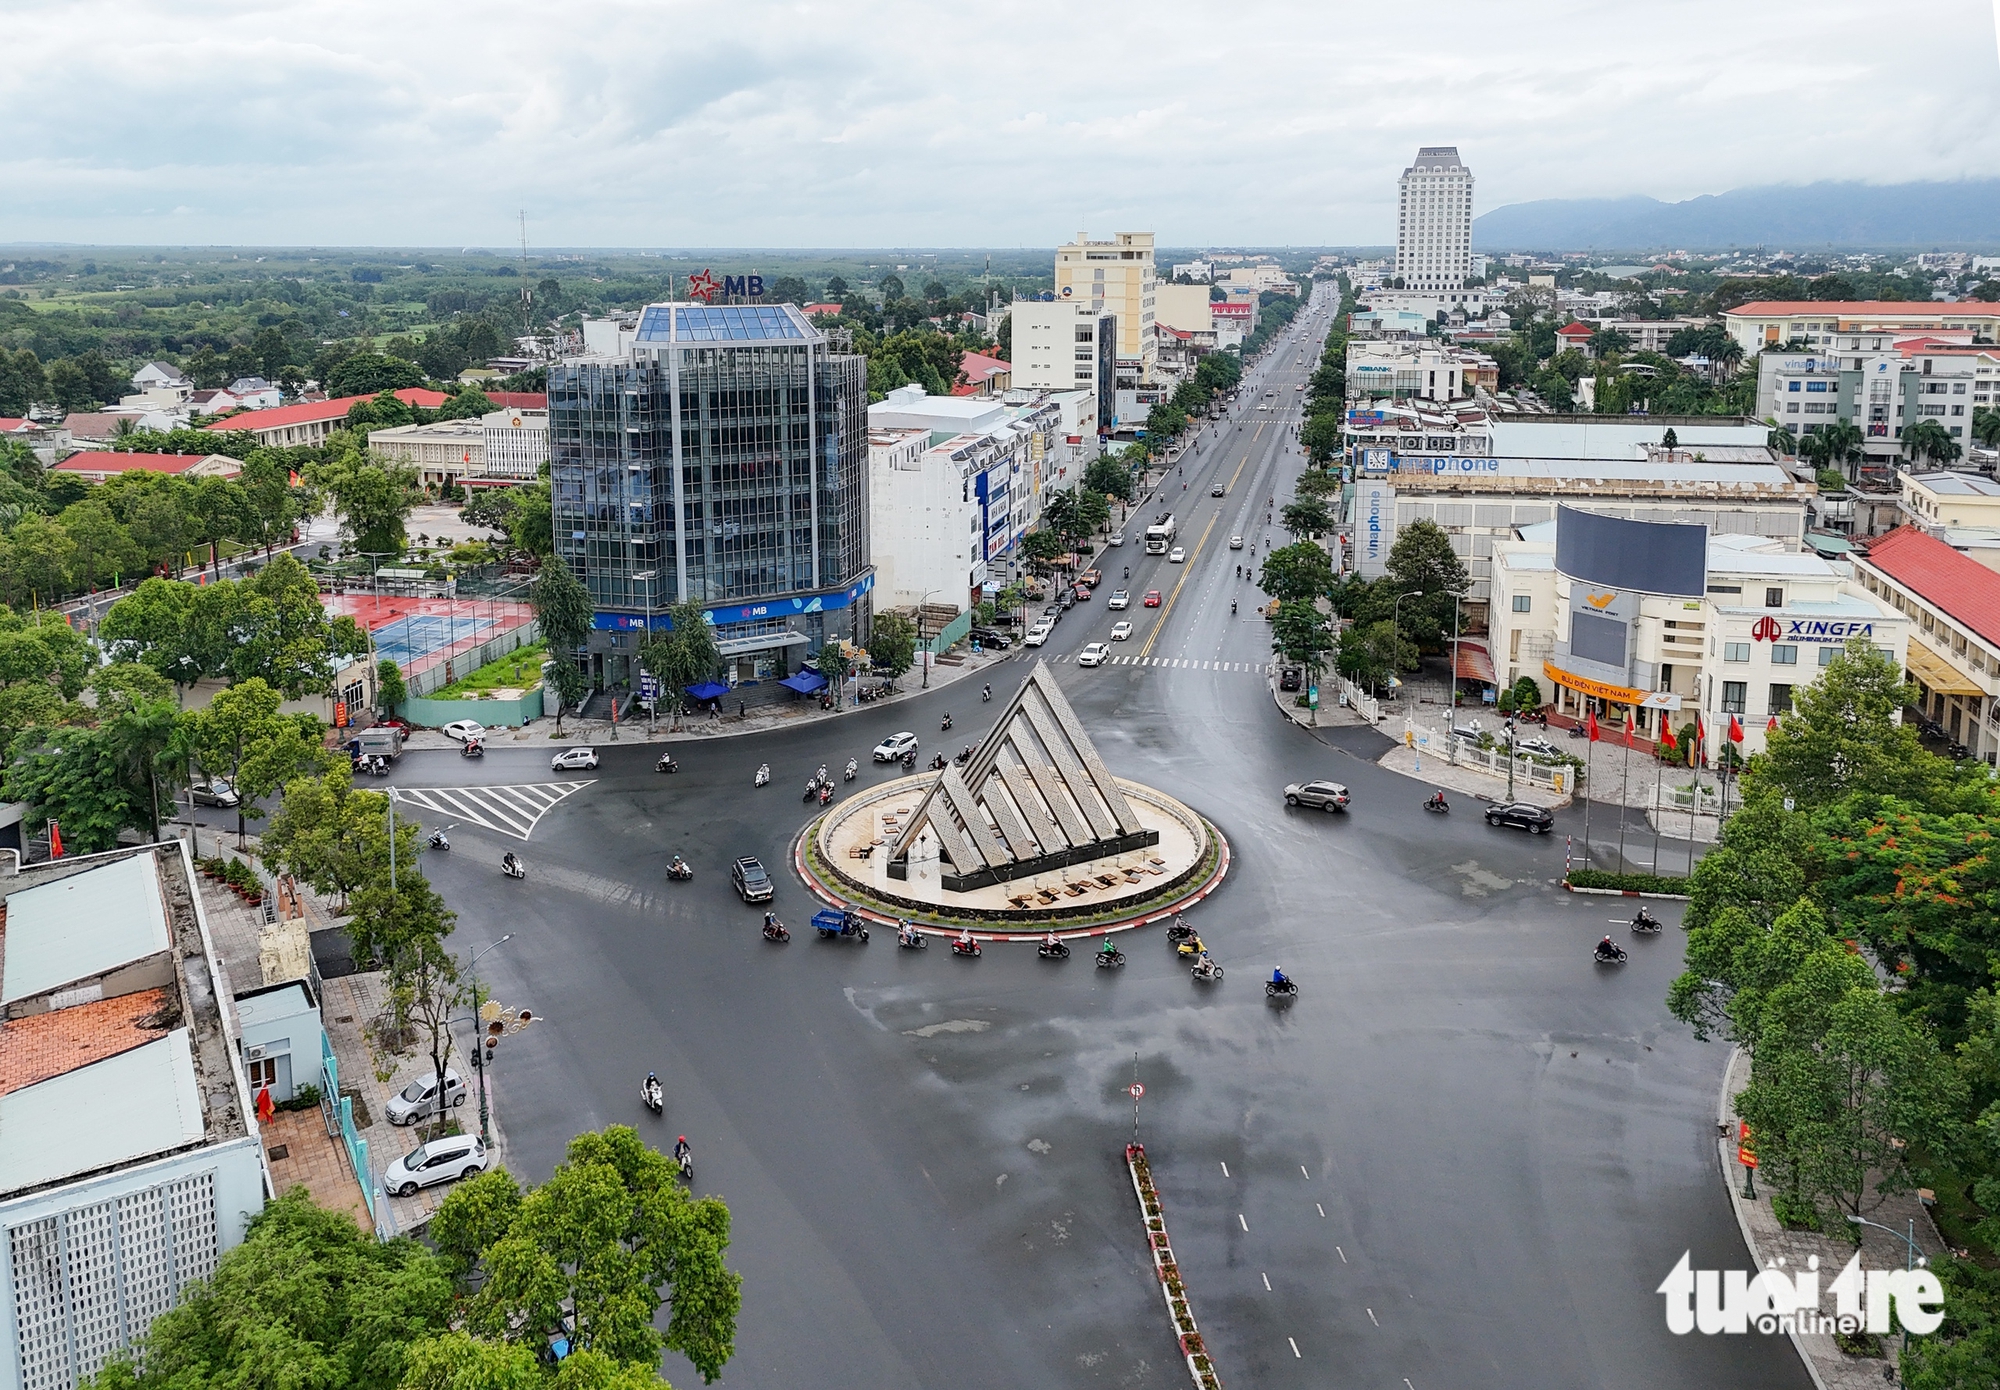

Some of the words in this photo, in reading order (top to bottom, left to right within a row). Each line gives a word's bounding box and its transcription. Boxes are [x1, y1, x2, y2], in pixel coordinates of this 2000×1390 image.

[724, 275, 764, 296] MB
[1390, 454, 1499, 475] vinaphone
[1367, 490, 1381, 559] vinaphone
[752, 606, 767, 616] MB
[1581, 605, 1603, 614] VIETNAM
[629, 618, 644, 628] MB
[1788, 620, 1872, 636] XINGFA
[1574, 679, 1590, 691] ĐIỆN
[1591, 684, 1609, 696] VIỆT
[1609, 688, 1631, 699] NAM
